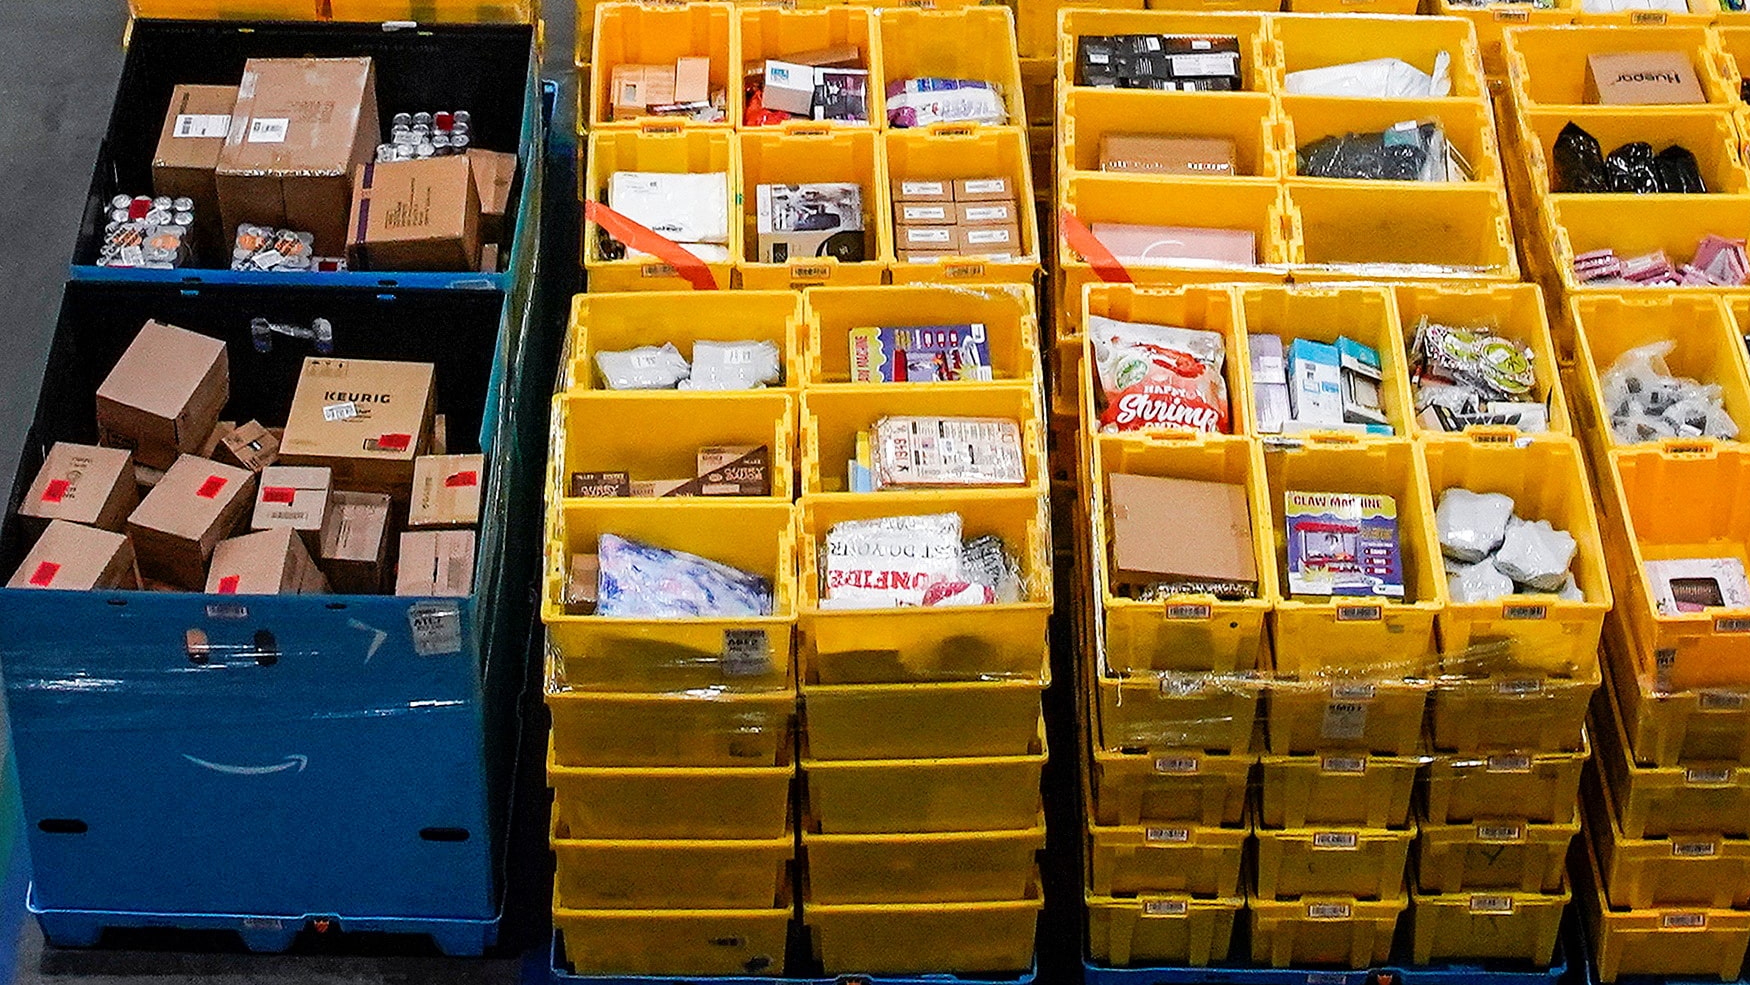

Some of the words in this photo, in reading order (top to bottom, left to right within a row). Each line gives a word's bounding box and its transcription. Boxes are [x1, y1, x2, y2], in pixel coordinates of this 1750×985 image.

[324, 391, 391, 404] KEURIG
[1116, 393, 1219, 433] Shrimp
[1294, 496, 1327, 507] CLAW
